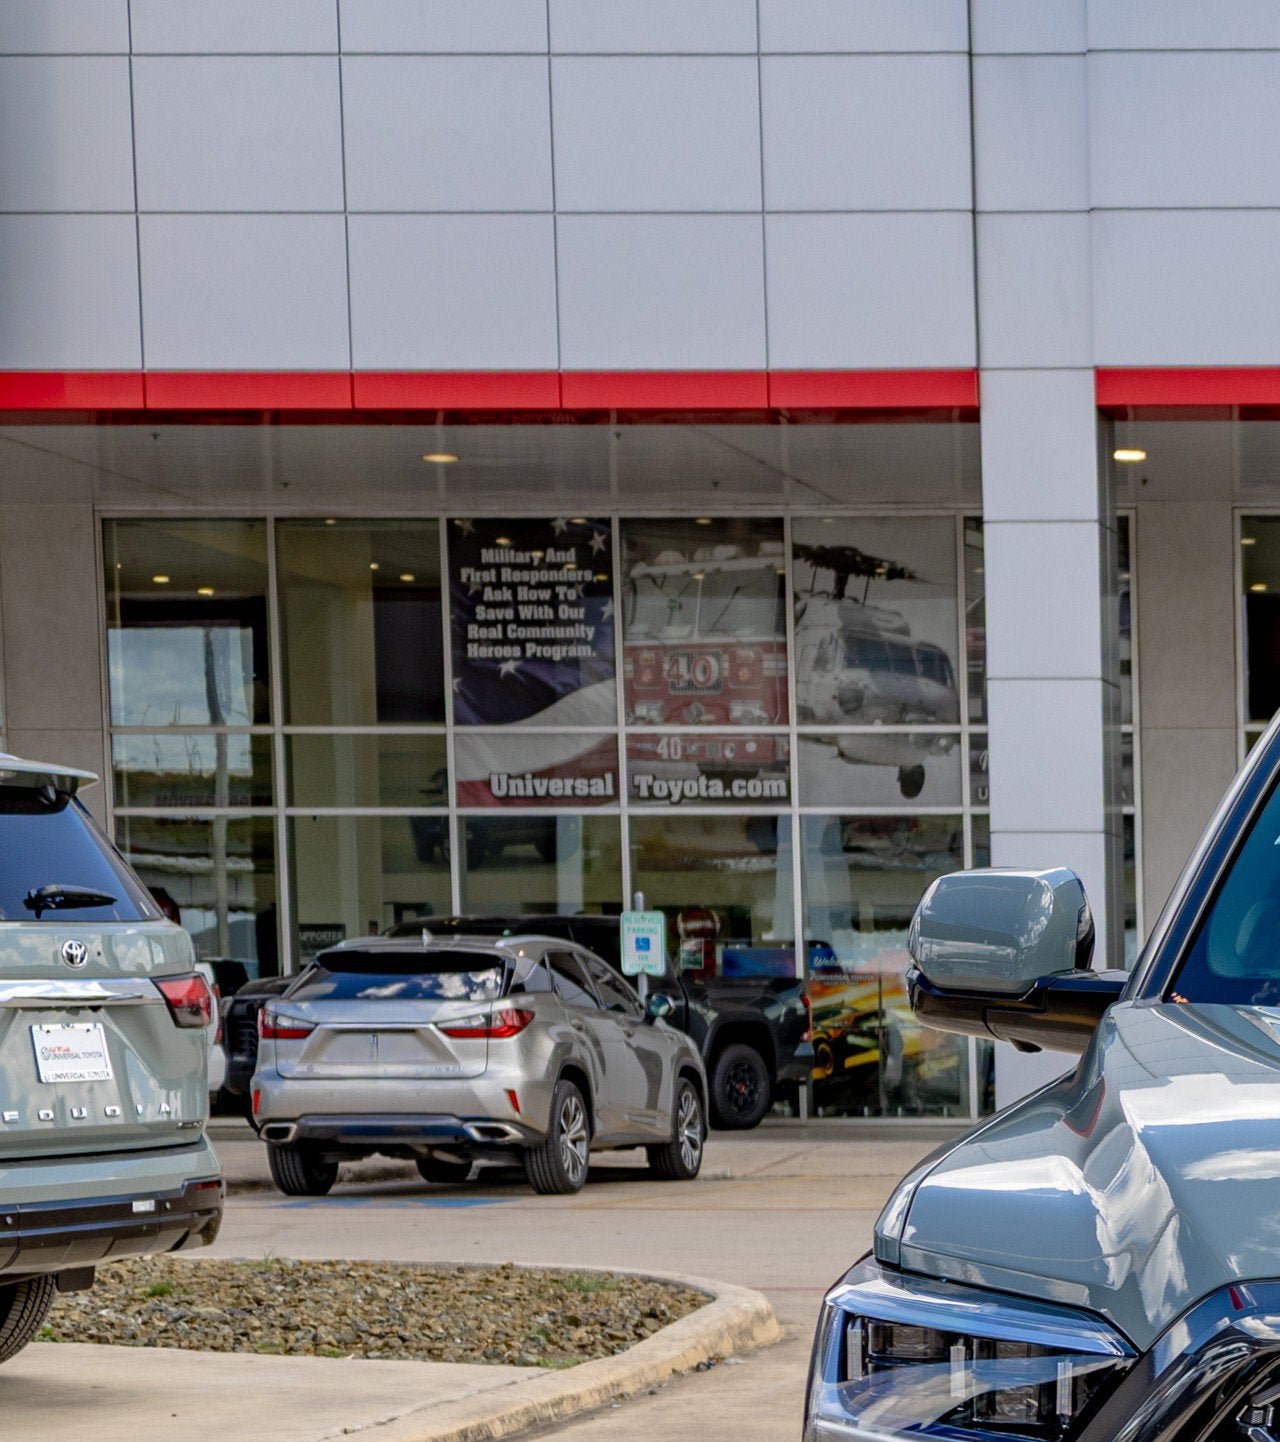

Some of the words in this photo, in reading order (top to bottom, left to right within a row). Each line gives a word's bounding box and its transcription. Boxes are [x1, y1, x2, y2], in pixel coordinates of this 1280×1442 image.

[481, 548, 544, 566] Military
[545, 547, 576, 563] And
[460, 567, 497, 583] First
[483, 586, 513, 601] Ask
[517, 586, 552, 601] How
[555, 586, 577, 601] To
[475, 605, 514, 620] Save
[517, 604, 554, 619] With
[558, 604, 585, 619] Our
[467, 623, 502, 639] Real
[506, 622, 595, 641] Community
[467, 642, 521, 658] Heroes
[525, 642, 597, 661] Program.
[665, 651, 719, 689] 40
[656, 736, 682, 759] 40
[489, 772, 614, 798] Universal
[634, 773, 788, 804] Toyota.com
[299, 931, 344, 941] UPPORTER
[2, 1101, 172, 1124] EQUOIA
